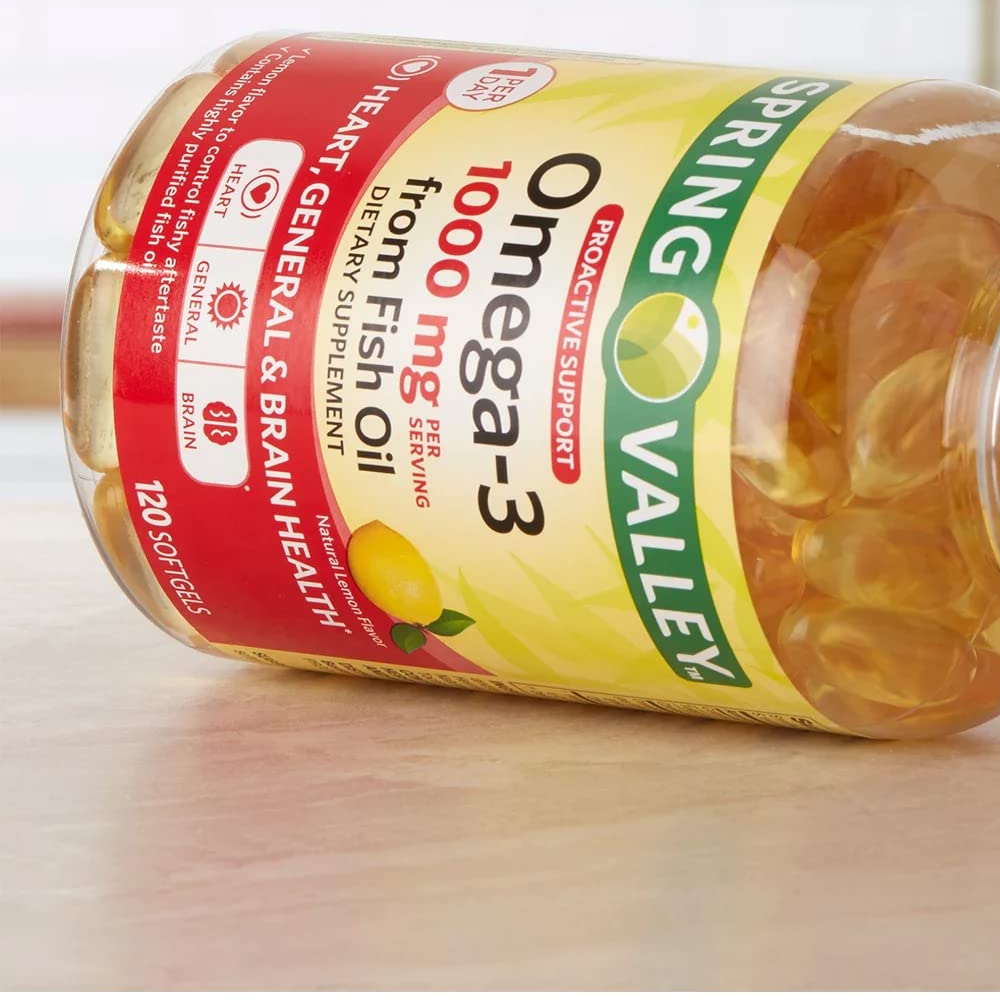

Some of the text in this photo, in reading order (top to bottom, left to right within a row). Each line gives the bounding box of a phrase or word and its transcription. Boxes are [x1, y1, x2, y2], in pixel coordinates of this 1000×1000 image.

[225, 53, 283, 96] Contains
[462, 76, 501, 100] DAY
[483, 78, 524, 102] PER
[488, 68, 538, 77] 1
[191, 98, 234, 140] highly
[309, 83, 400, 176] HEART,
[151, 54, 306, 354] Lemon flavor to control fishy aftertaste
[160, 143, 199, 208] purified
[214, 164, 247, 218] HEART
[649, 79, 822, 276] SPRING
[147, 212, 171, 245] fish
[262, 182, 331, 347] GENERAL
[184, 261, 210, 346] GENERAL
[325, 185, 390, 456] DIETARY SUPPLEMENT
[354, 176, 442, 475] from Fish Oil
[400, 160, 512, 408] 1000 mg
[260, 355, 288, 383] &
[459, 152, 603, 537] Omega-3
[555, 219, 615, 471] PROACTIVE SUPPORT
[182, 392, 197, 450] BRAIN
[260, 393, 297, 507] BRAIN
[408, 417, 431, 509] SERVING
[426, 418, 441, 458] PER
[134, 480, 211, 615] 120 SOFTGELS
[315, 514, 388, 649] Natural Lemon Flavor
[620, 420, 736, 680] VALLEY
